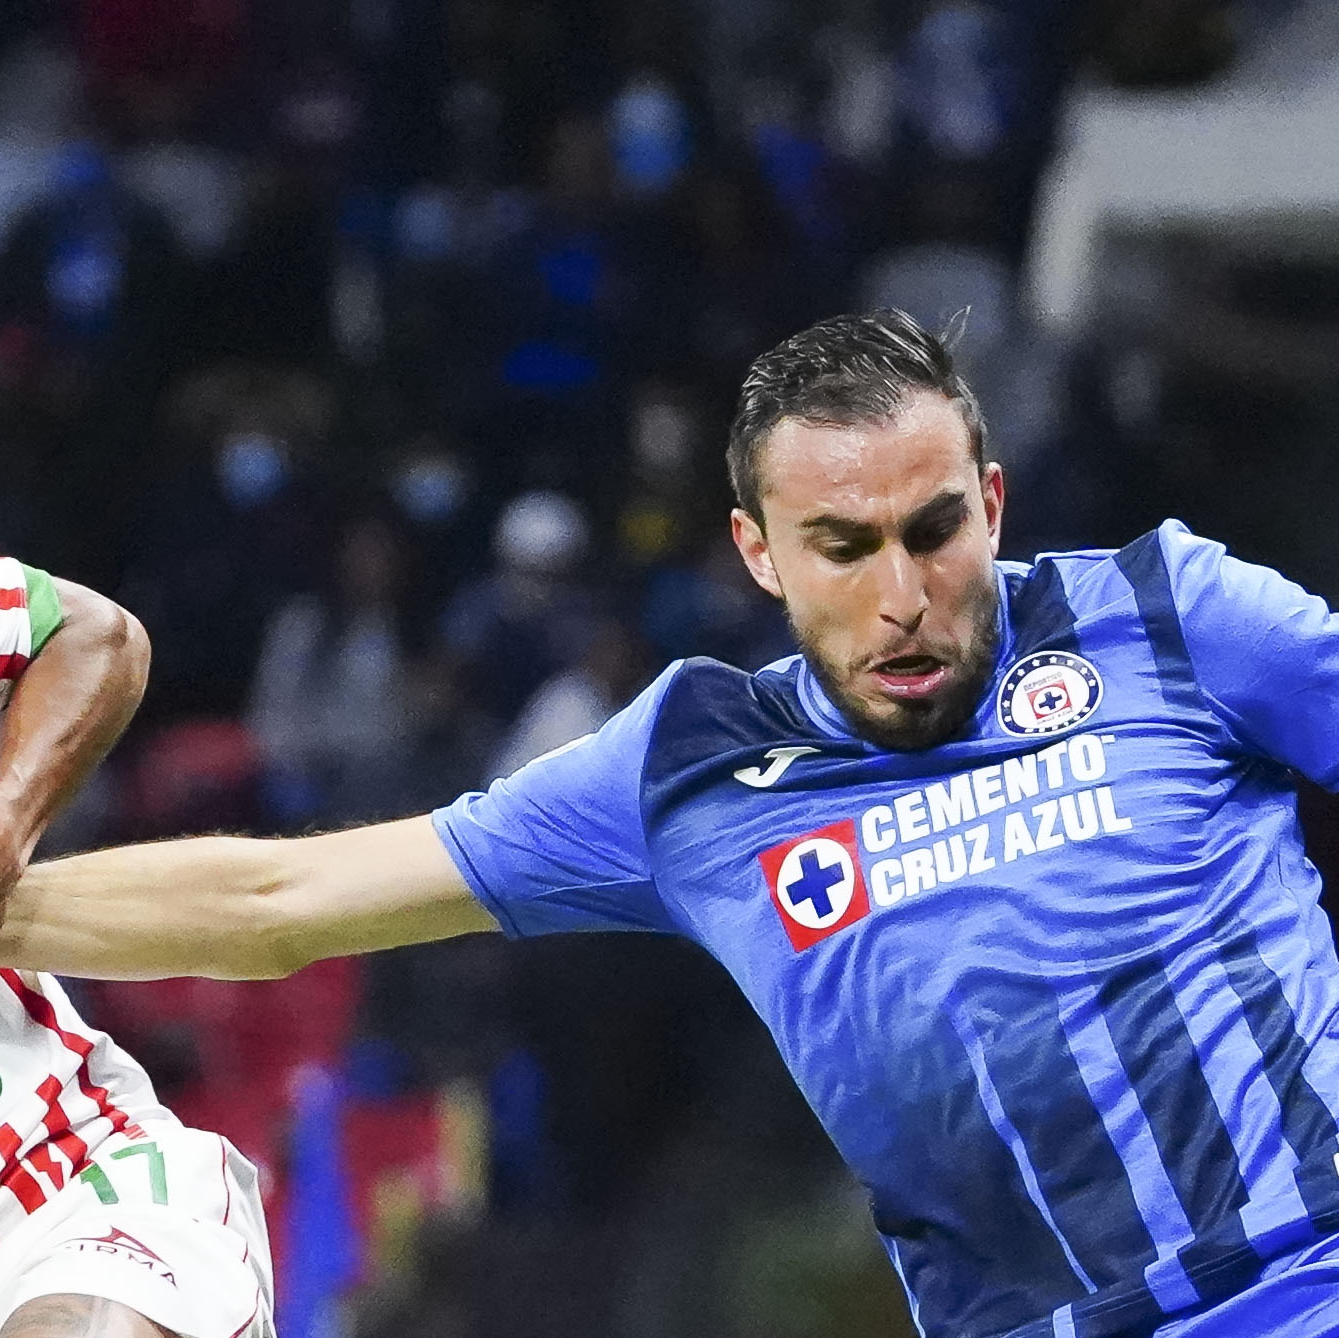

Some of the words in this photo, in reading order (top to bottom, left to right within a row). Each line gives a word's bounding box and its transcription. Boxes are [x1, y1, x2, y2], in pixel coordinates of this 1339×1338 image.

[861, 734, 1107, 853] CEMENTO
[870, 823, 997, 907] CRUZ
[1004, 786, 1134, 864] AZUL
[80, 1142, 168, 1206] 17
